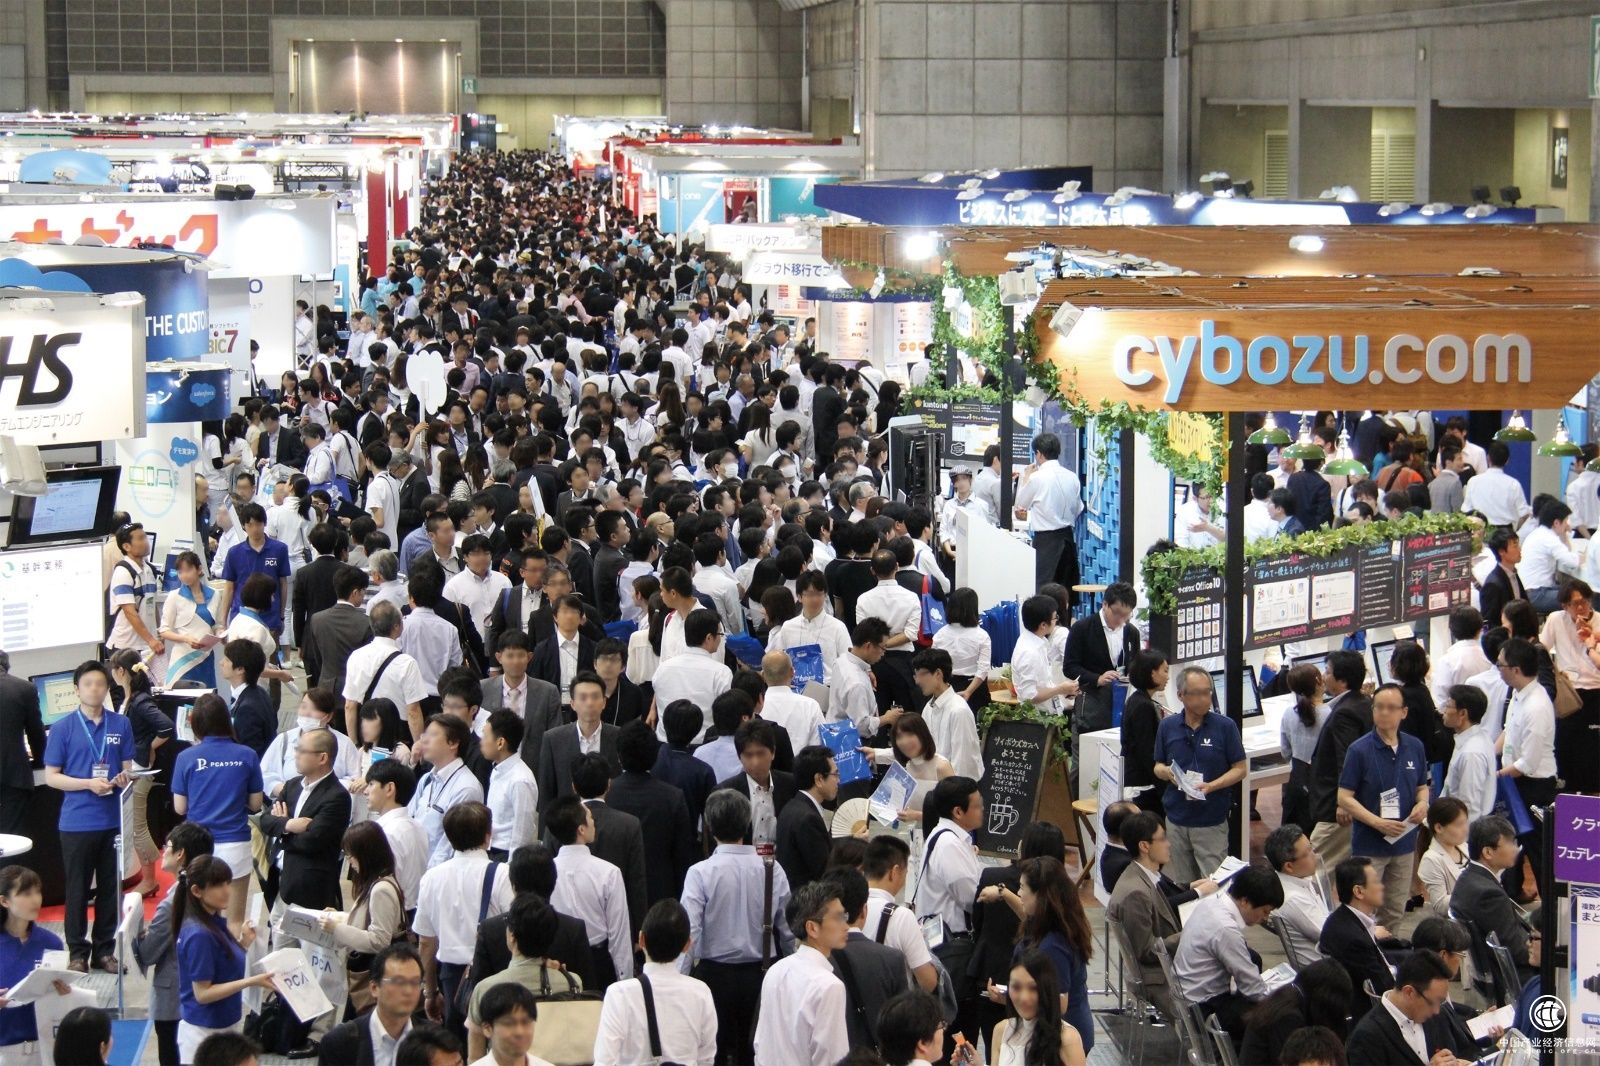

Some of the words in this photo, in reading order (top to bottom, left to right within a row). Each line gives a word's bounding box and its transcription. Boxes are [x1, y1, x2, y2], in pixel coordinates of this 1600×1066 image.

[145, 314, 173, 337] THE
[1112, 318, 1532, 404] cybozu.com
[1212, 577, 1221, 589] 10
[1001, 749, 1029, 761] ようこそ
